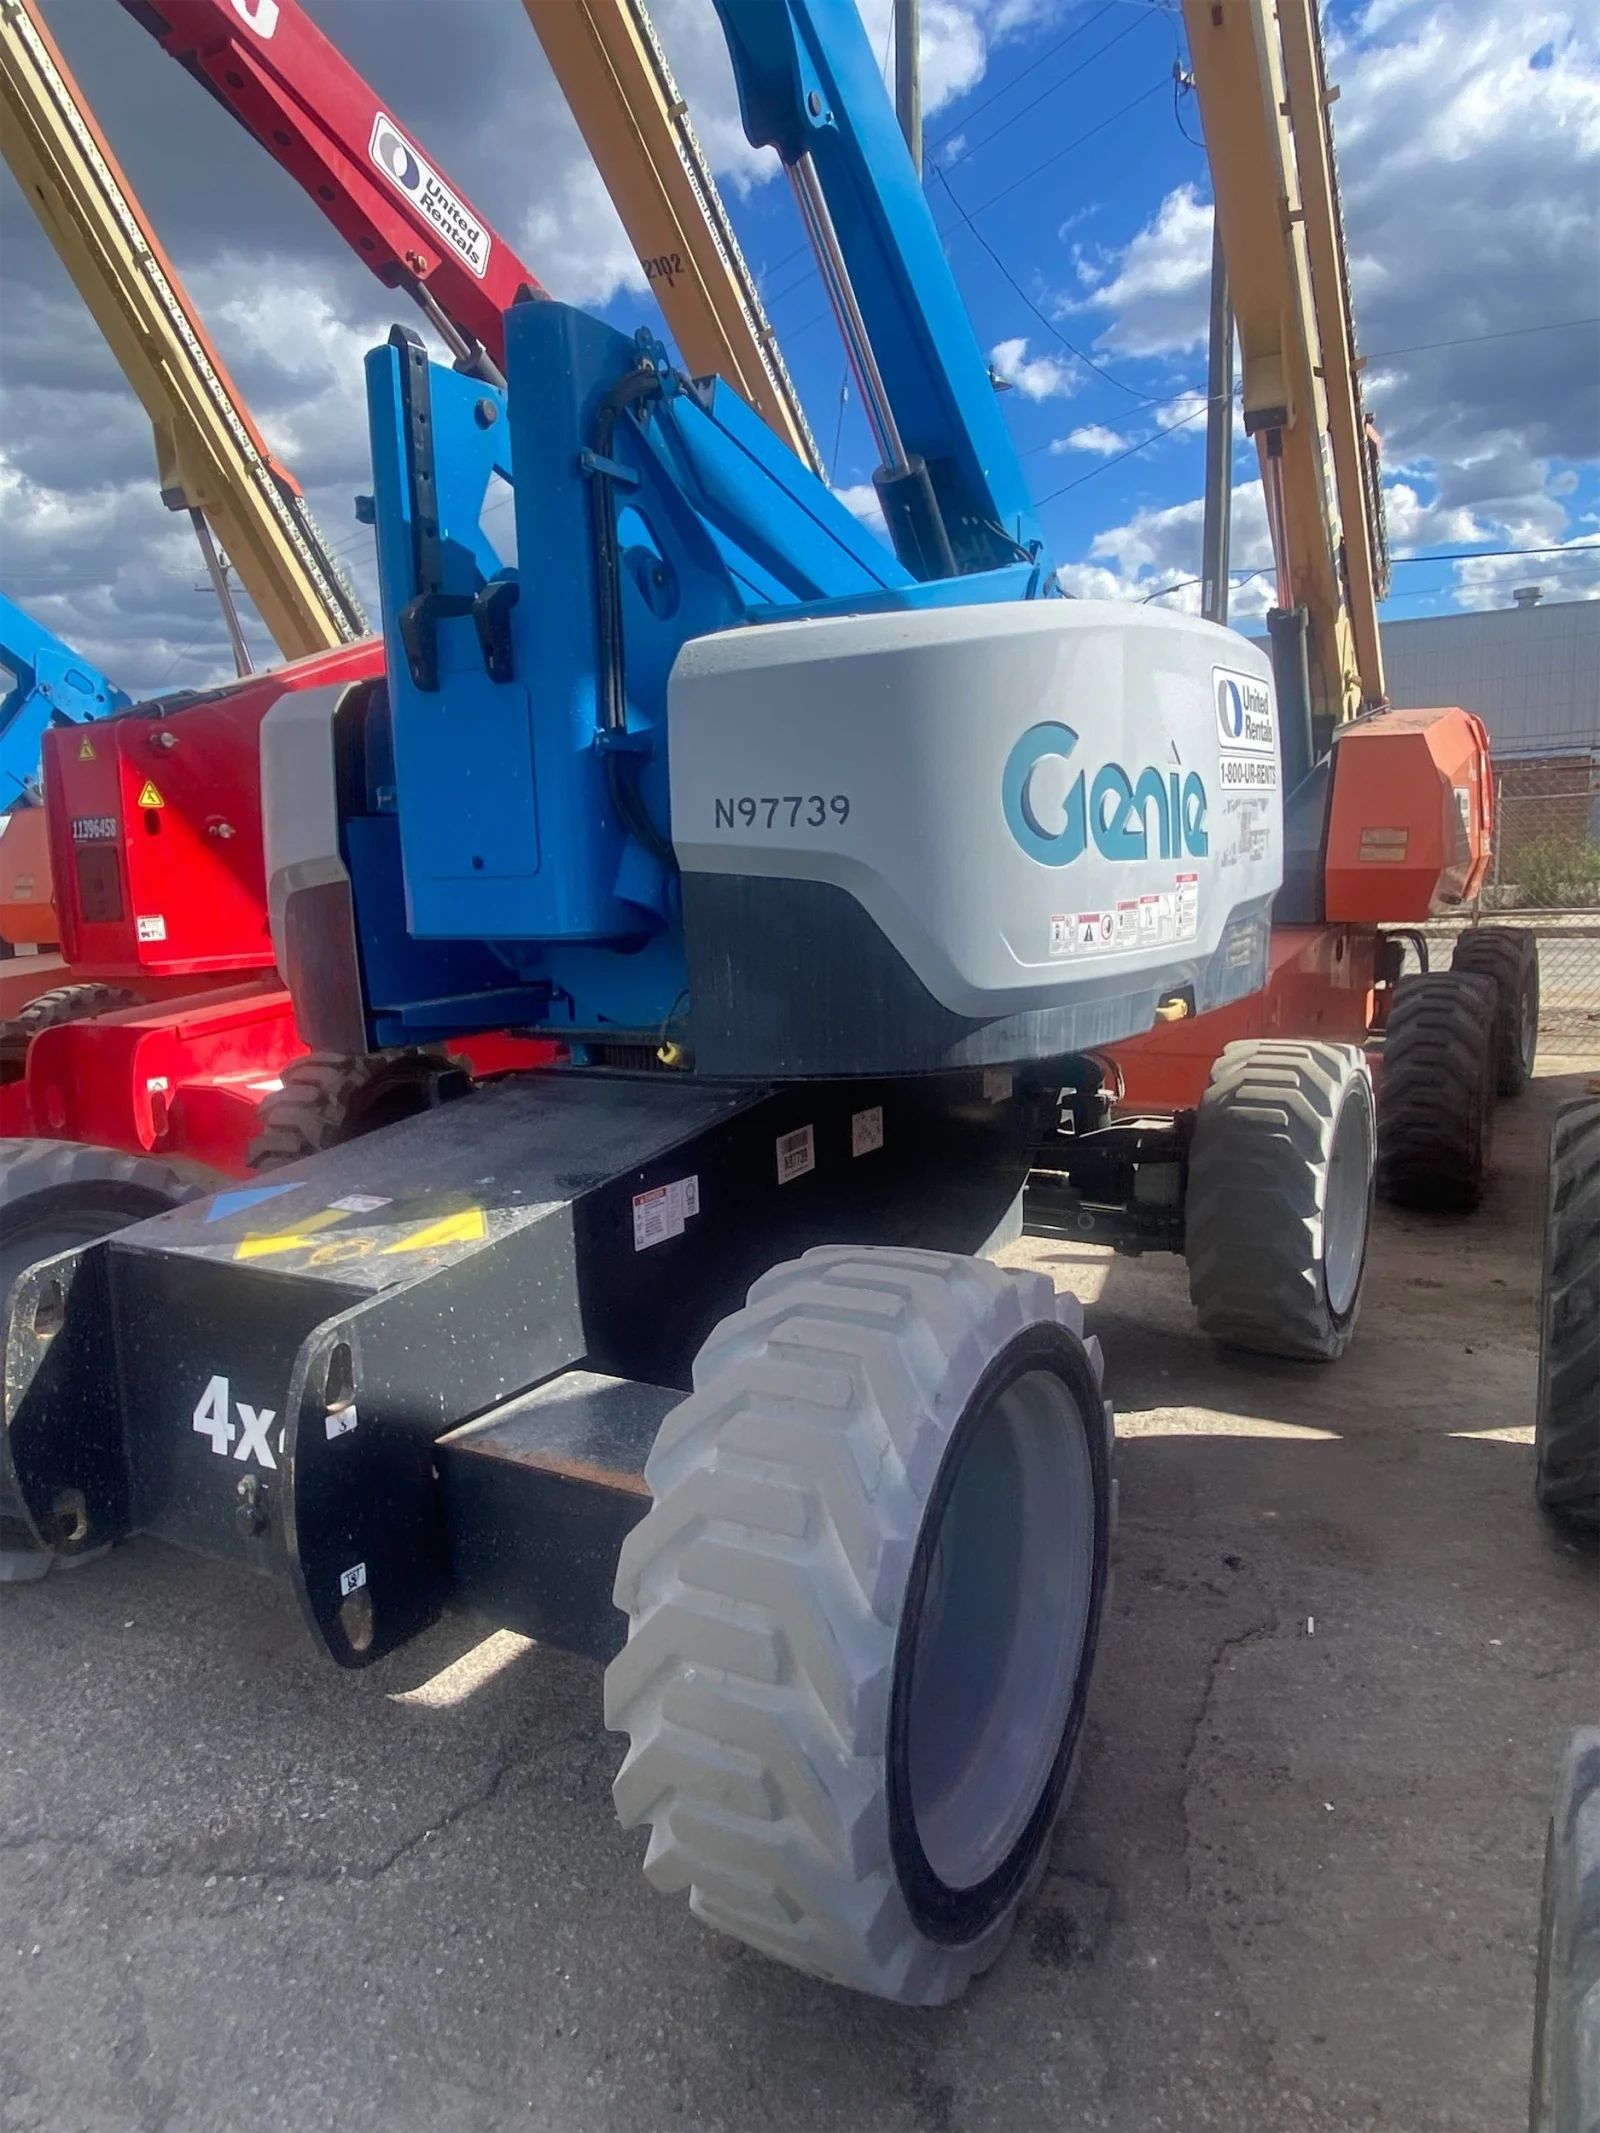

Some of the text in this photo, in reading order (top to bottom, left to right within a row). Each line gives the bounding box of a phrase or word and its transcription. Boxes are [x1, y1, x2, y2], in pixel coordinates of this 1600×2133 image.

[426, 177, 480, 244] United
[419, 193, 480, 265] Rentals
[1242, 685, 1269, 717] United
[1244, 714, 1273, 743] Rentals
[1220, 764, 1277, 786] 1-800-UR-RENTS
[1002, 720, 1208, 867] Genie
[73, 818, 117, 839] 11396458
[714, 794, 851, 829] N97739
[193, 1375, 285, 1470] 4x
